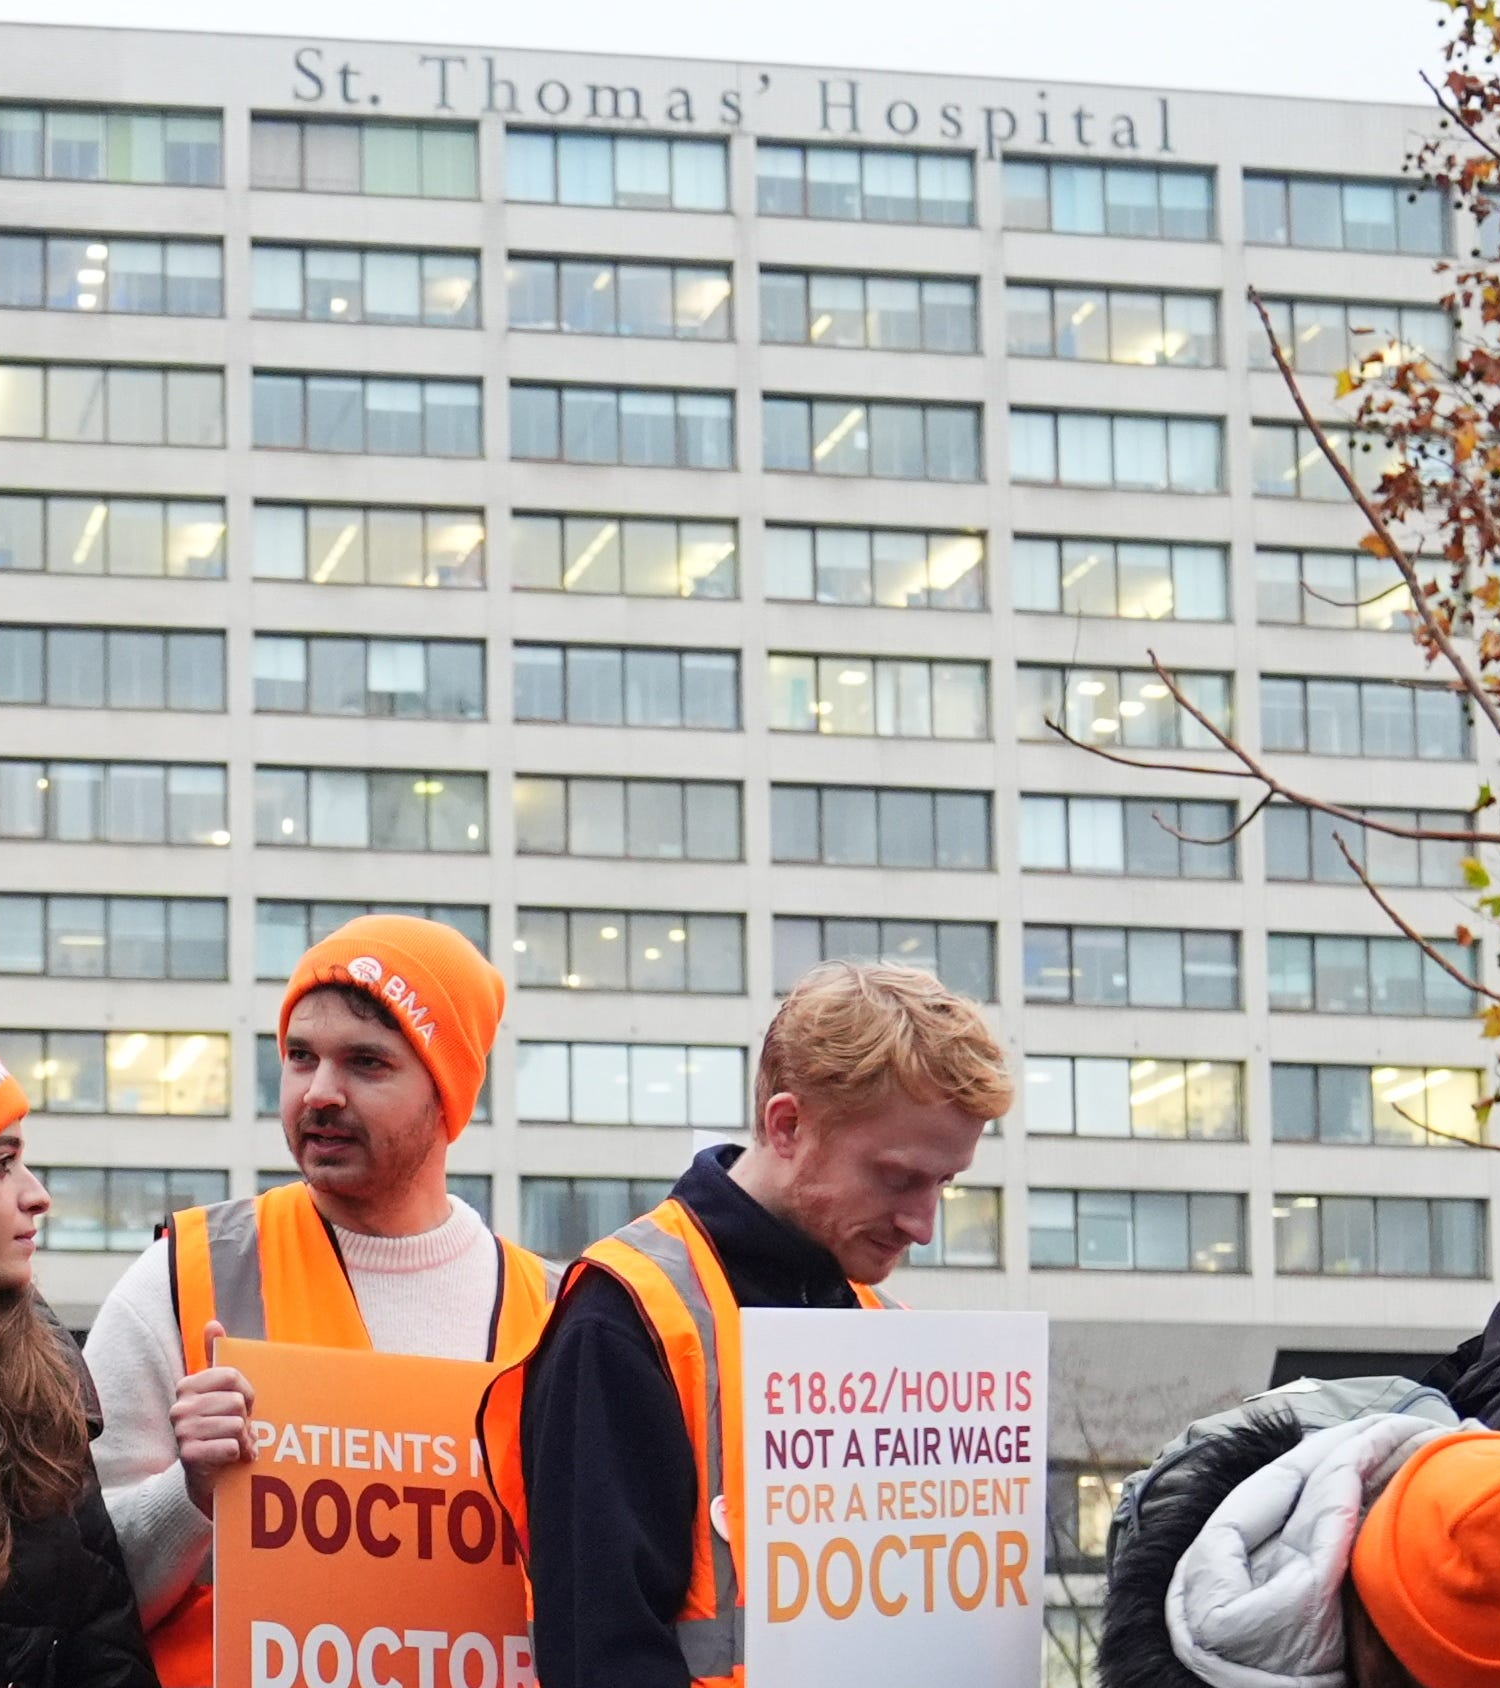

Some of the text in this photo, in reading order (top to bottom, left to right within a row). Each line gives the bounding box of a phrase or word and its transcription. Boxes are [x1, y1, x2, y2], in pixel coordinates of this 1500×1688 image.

[292, 46, 1176, 162] St. Thomas' Hospital
[383, 975, 436, 1047] BMA
[765, 1368, 1032, 1415] £18.62/HOUR IS
[254, 1420, 456, 1477] PATIENTS
[766, 1425, 1030, 1469] NOT A FAIR WAGE
[767, 1477, 1030, 1525] FOR A RESIDENT
[767, 1531, 1029, 1623] DOCTOR
